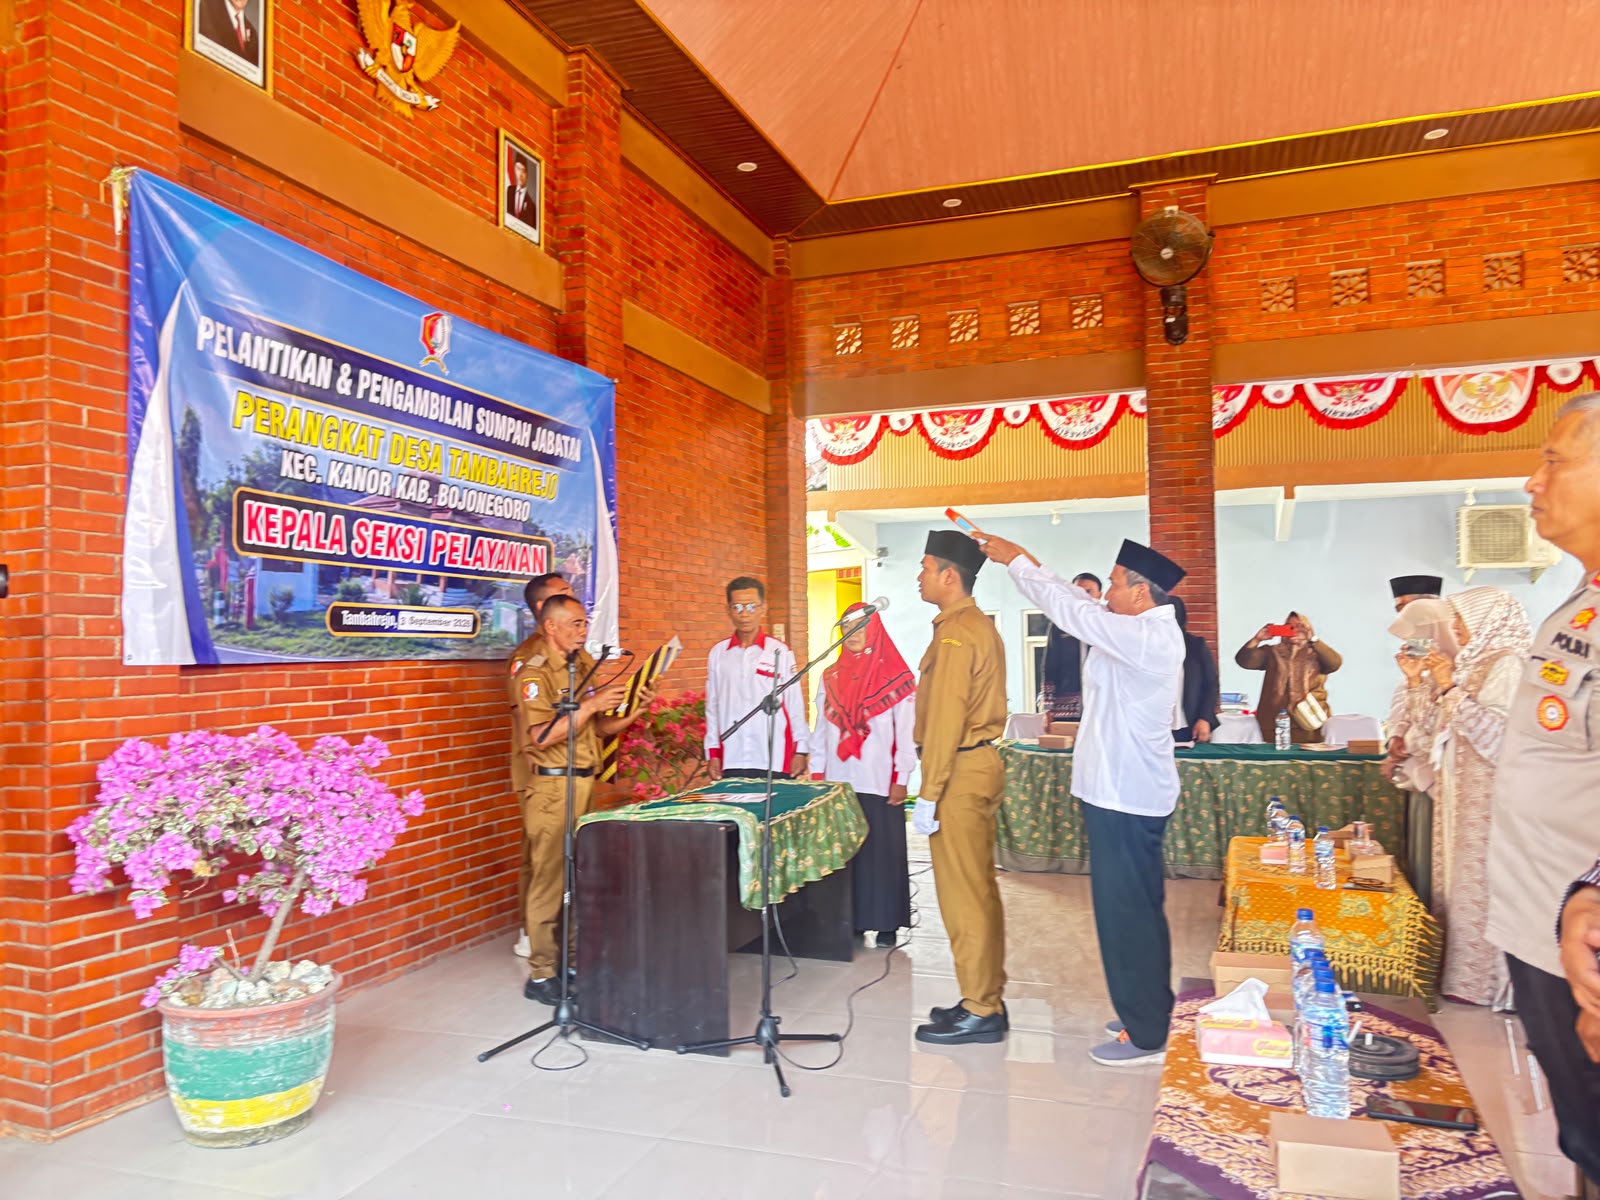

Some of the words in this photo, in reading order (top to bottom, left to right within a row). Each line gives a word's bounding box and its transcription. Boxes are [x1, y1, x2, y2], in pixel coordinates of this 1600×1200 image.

[196, 315, 333, 389] PELANTIKAN
[336, 362, 353, 396] &
[357, 368, 474, 430] PENGAMBILAN
[476, 407, 532, 448] SUMPAH
[532, 427, 582, 462] JABATAN
[232, 390, 385, 460] PERANGKAT
[388, 432, 443, 475] DESA
[449, 446, 560, 500] TAMBAHREJO
[280, 449, 323, 484] KEC.
[327, 459, 393, 496] KANOR
[395, 474, 432, 504] KAB.
[436, 483, 531, 522] BOJONEGORO
[244, 500, 347, 555] KEPALA
[352, 518, 427, 563] SEKSI
[429, 530, 547, 575] PELAYANAN
[341, 609, 398, 629] Tambahrejo,
[408, 615, 452, 628] September
[1550, 631, 1590, 658] POLRI
